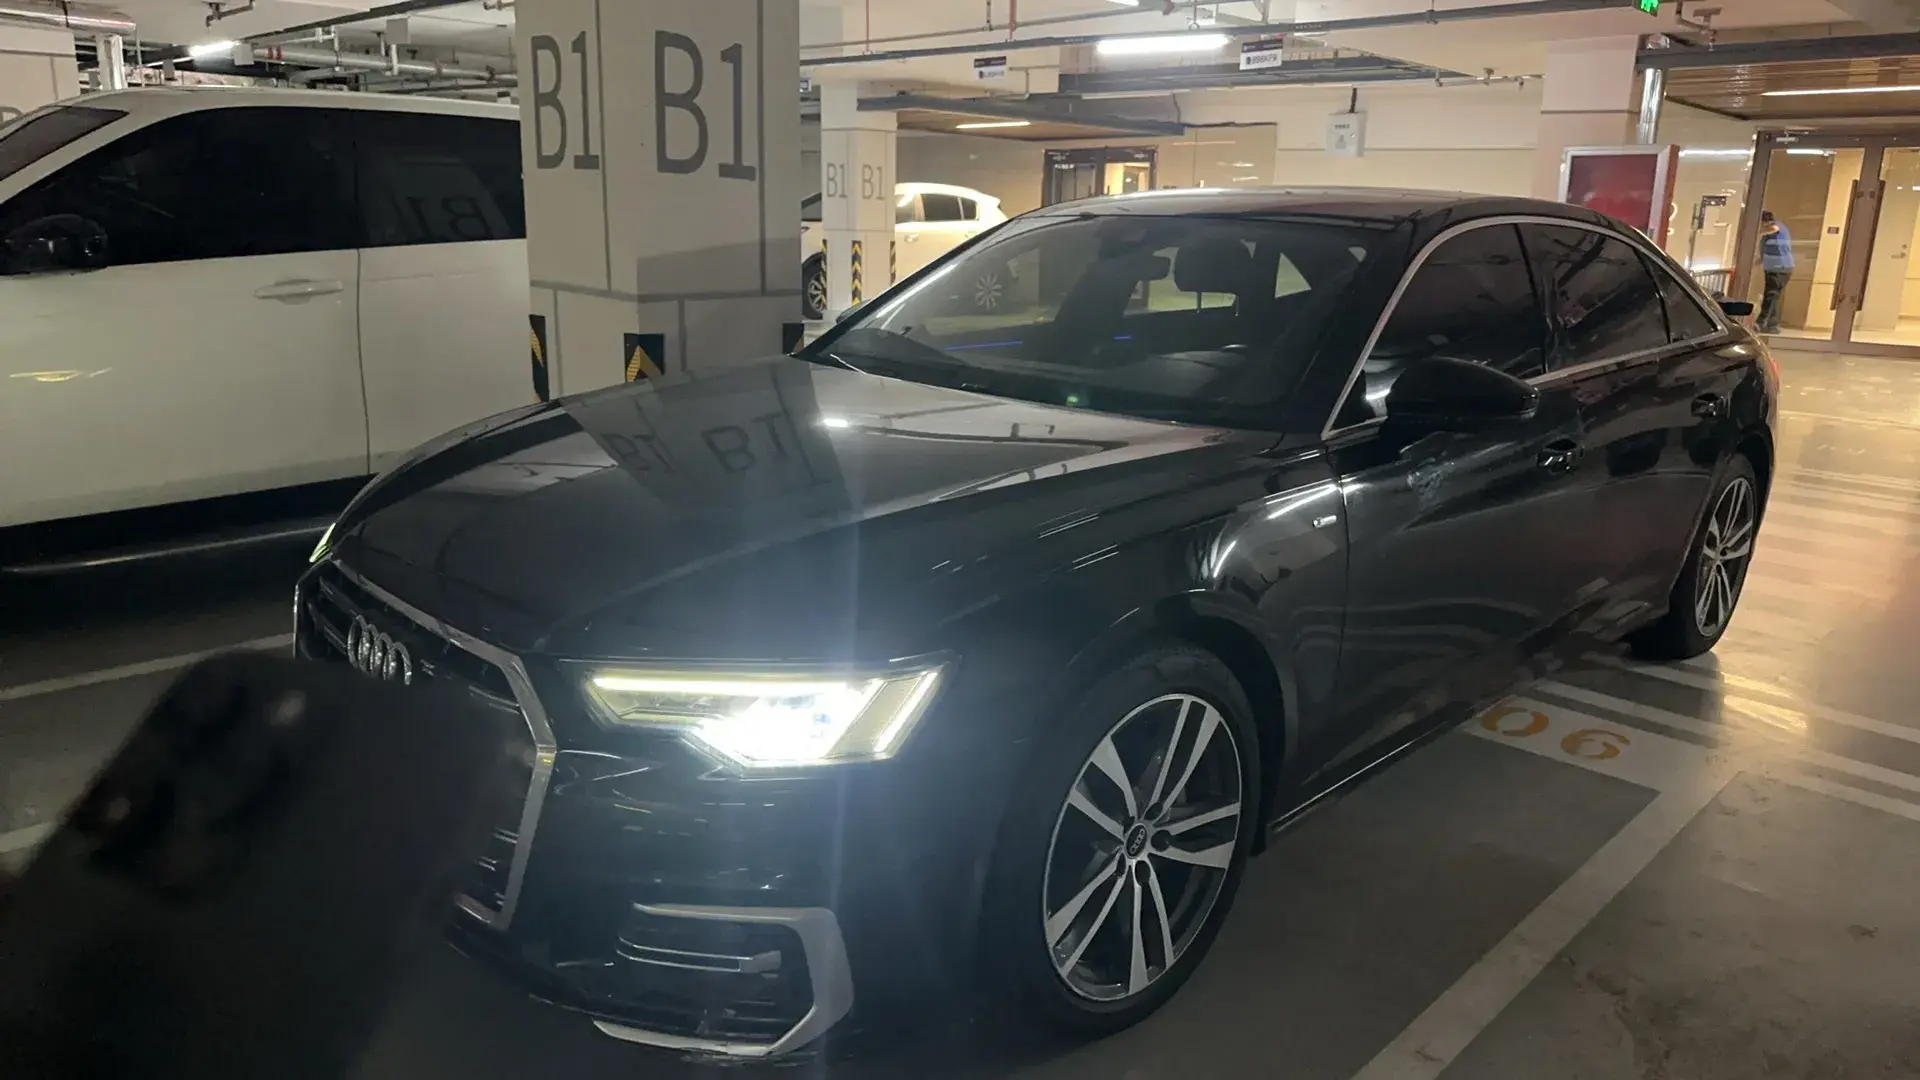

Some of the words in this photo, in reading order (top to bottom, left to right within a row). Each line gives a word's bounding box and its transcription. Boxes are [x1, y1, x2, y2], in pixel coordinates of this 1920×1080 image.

[530, 31, 600, 170] B1
[655, 30, 756, 181] B1
[826, 162, 847, 198] B1
[862, 164, 885, 200] B1
[1480, 706, 1631, 760] 06
